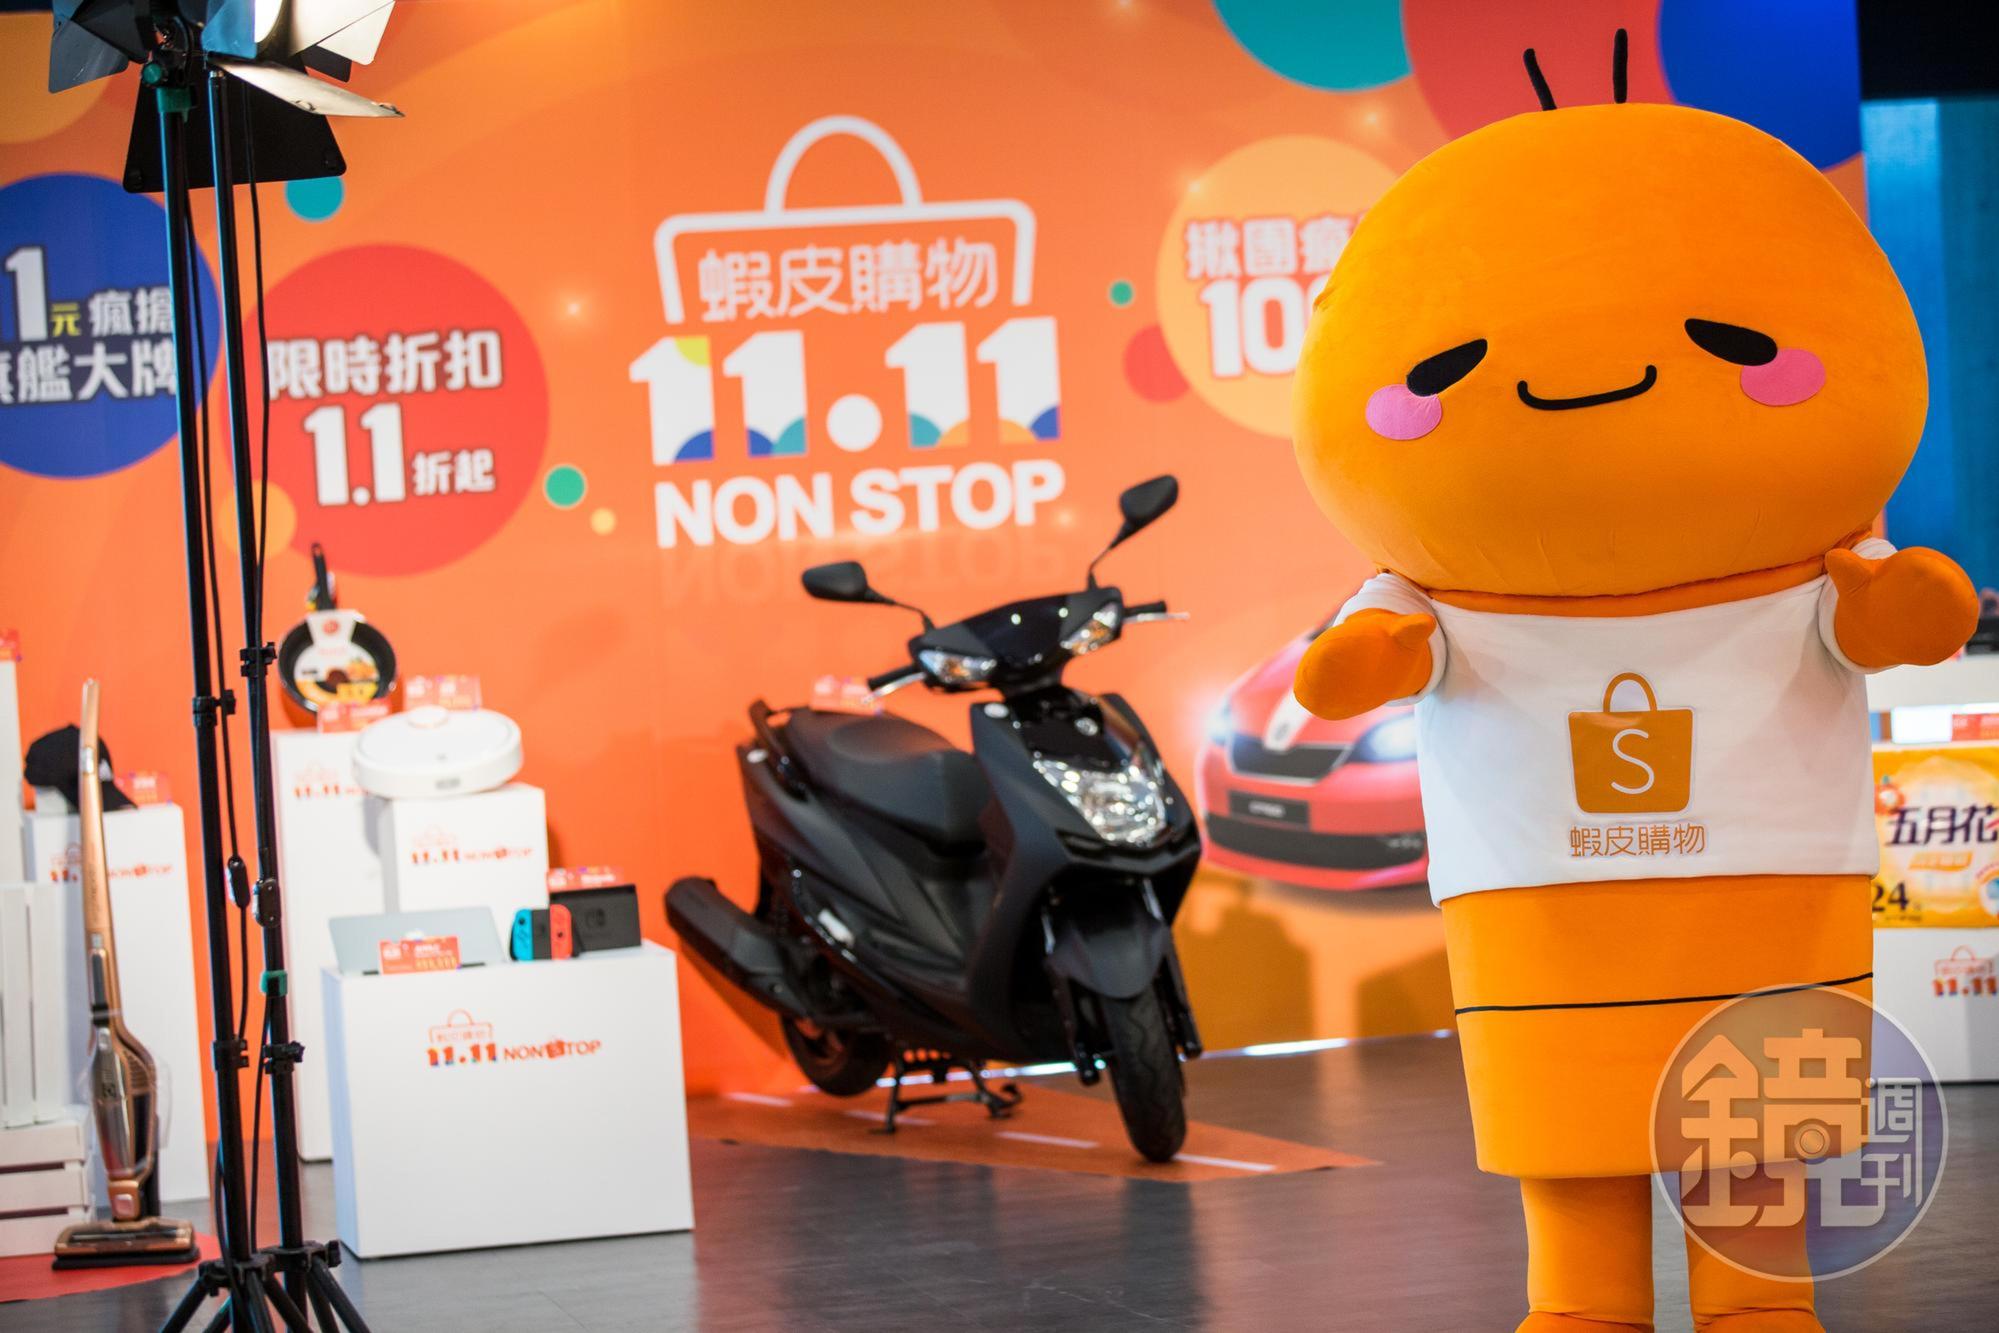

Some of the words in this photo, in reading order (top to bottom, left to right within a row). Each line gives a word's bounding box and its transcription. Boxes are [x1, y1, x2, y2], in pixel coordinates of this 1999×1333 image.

[698, 237, 999, 322] 蝦皮購物
[1185, 213, 1364, 279] 揪團瘋
[1200, 275, 1332, 377] 10
[0, 338, 177, 405] 艦大牌
[268, 331, 502, 400] 限時折扣
[629, 316, 1062, 466] 11.11
[654, 475, 834, 549] NON
[850, 460, 1066, 535] STOP
[1610, 728, 1655, 795] S
[1570, 823, 1705, 857] 蝦皮購物
[1886, 804, 1999, 846] 五月花
[427, 1042, 497, 1067] 11.11
